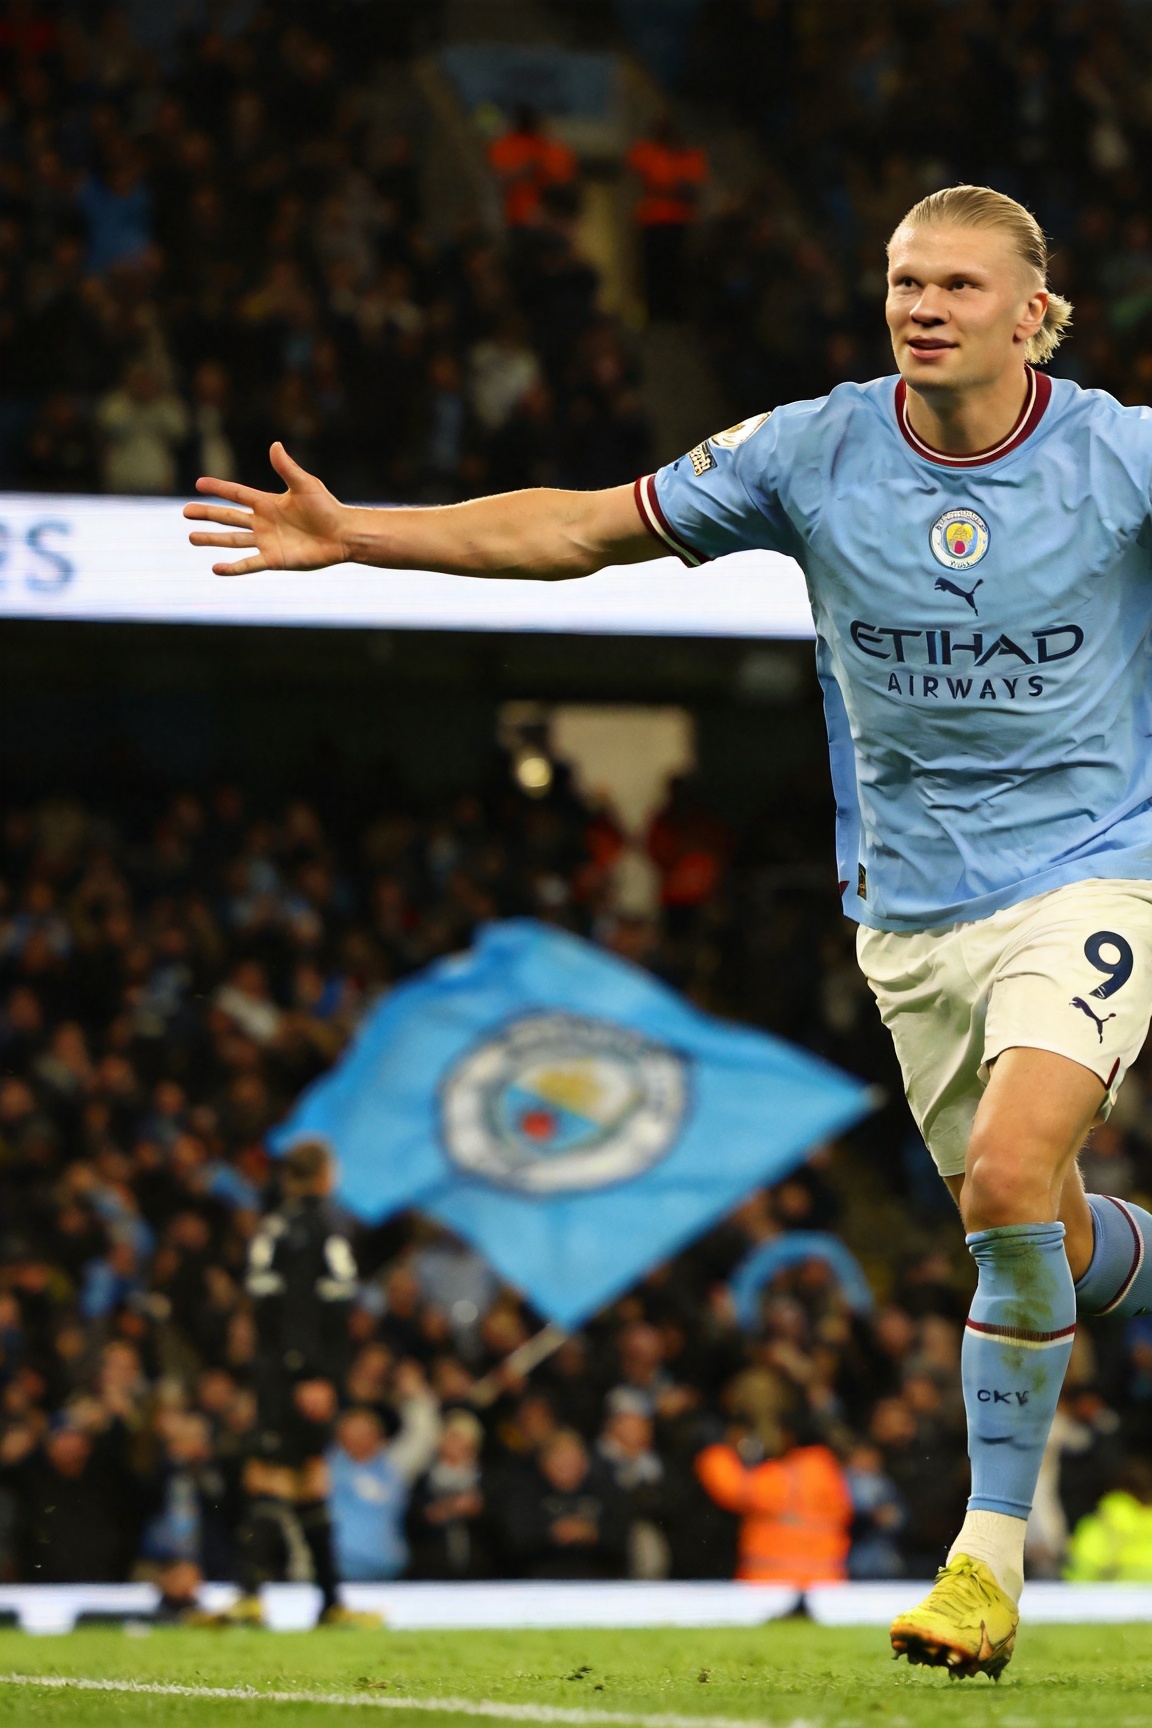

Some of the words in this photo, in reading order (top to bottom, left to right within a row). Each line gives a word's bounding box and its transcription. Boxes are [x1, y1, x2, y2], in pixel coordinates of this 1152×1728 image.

[850, 619, 1084, 667] ETIHAD
[887, 672, 1044, 700] AIRWAYS
[1084, 930, 1134, 1000] 9
